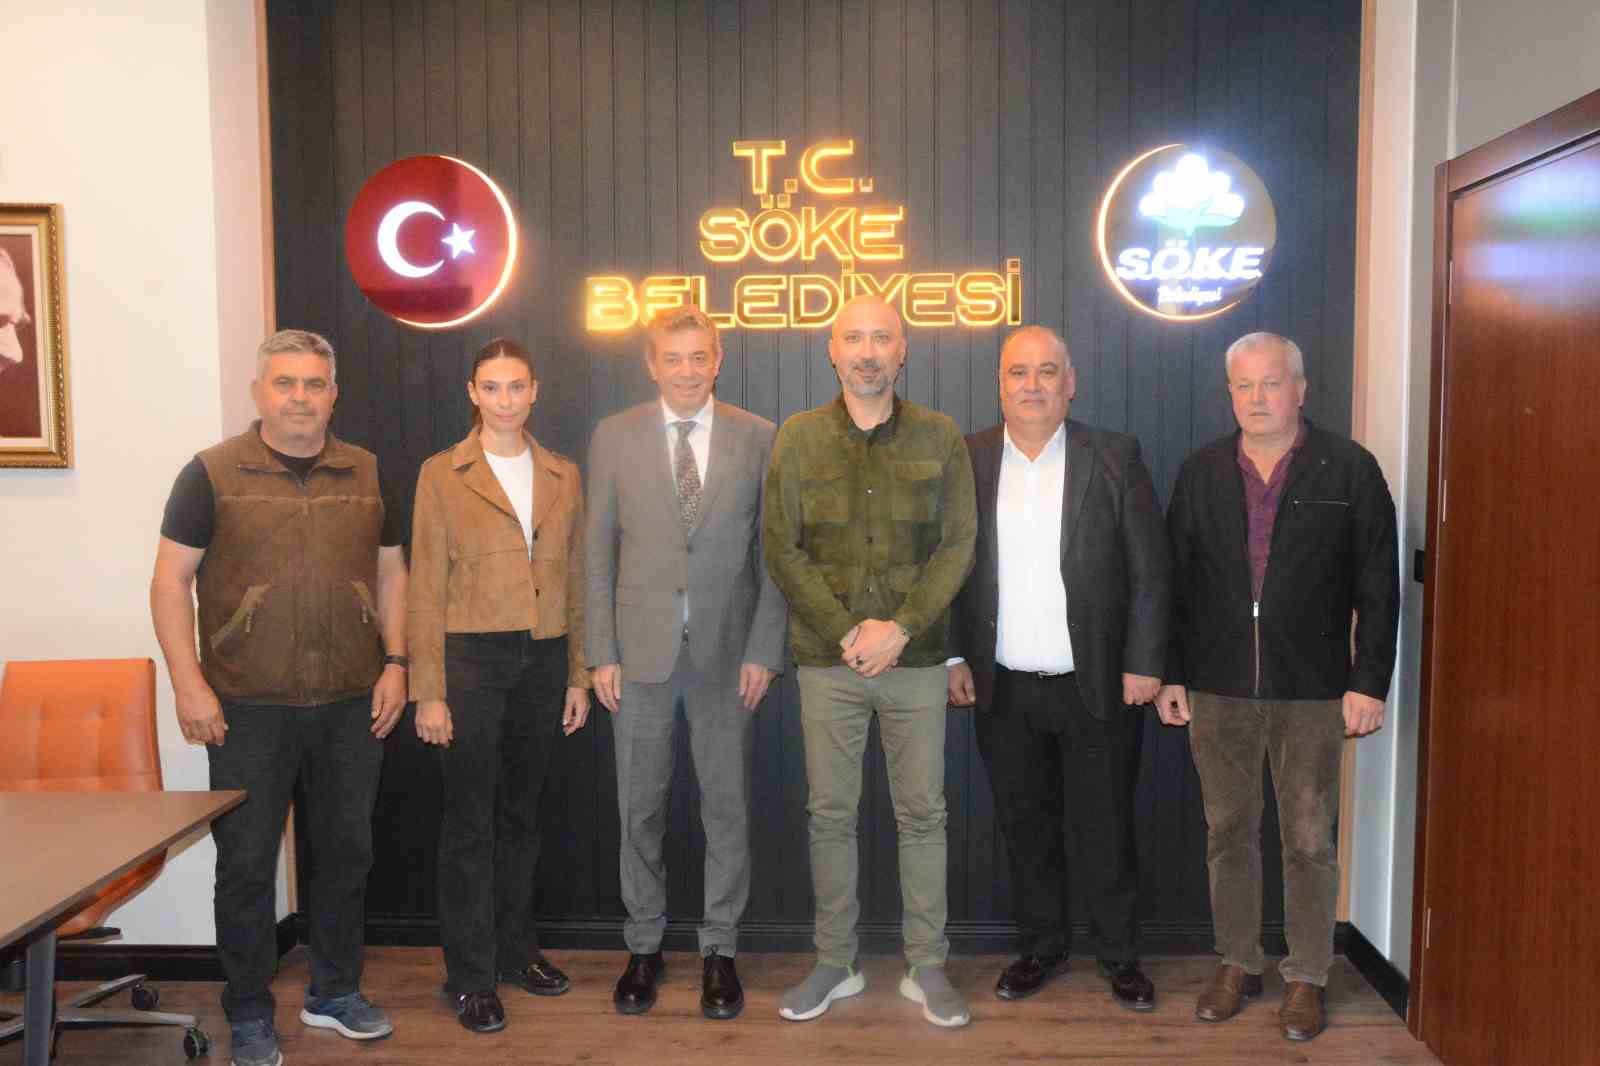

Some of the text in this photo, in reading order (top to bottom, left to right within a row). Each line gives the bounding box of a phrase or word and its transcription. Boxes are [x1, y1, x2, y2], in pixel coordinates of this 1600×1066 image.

[732, 139, 873, 195] T.C.
[699, 193, 904, 263] SÖKE
[1115, 239, 1265, 281] SÖKE
